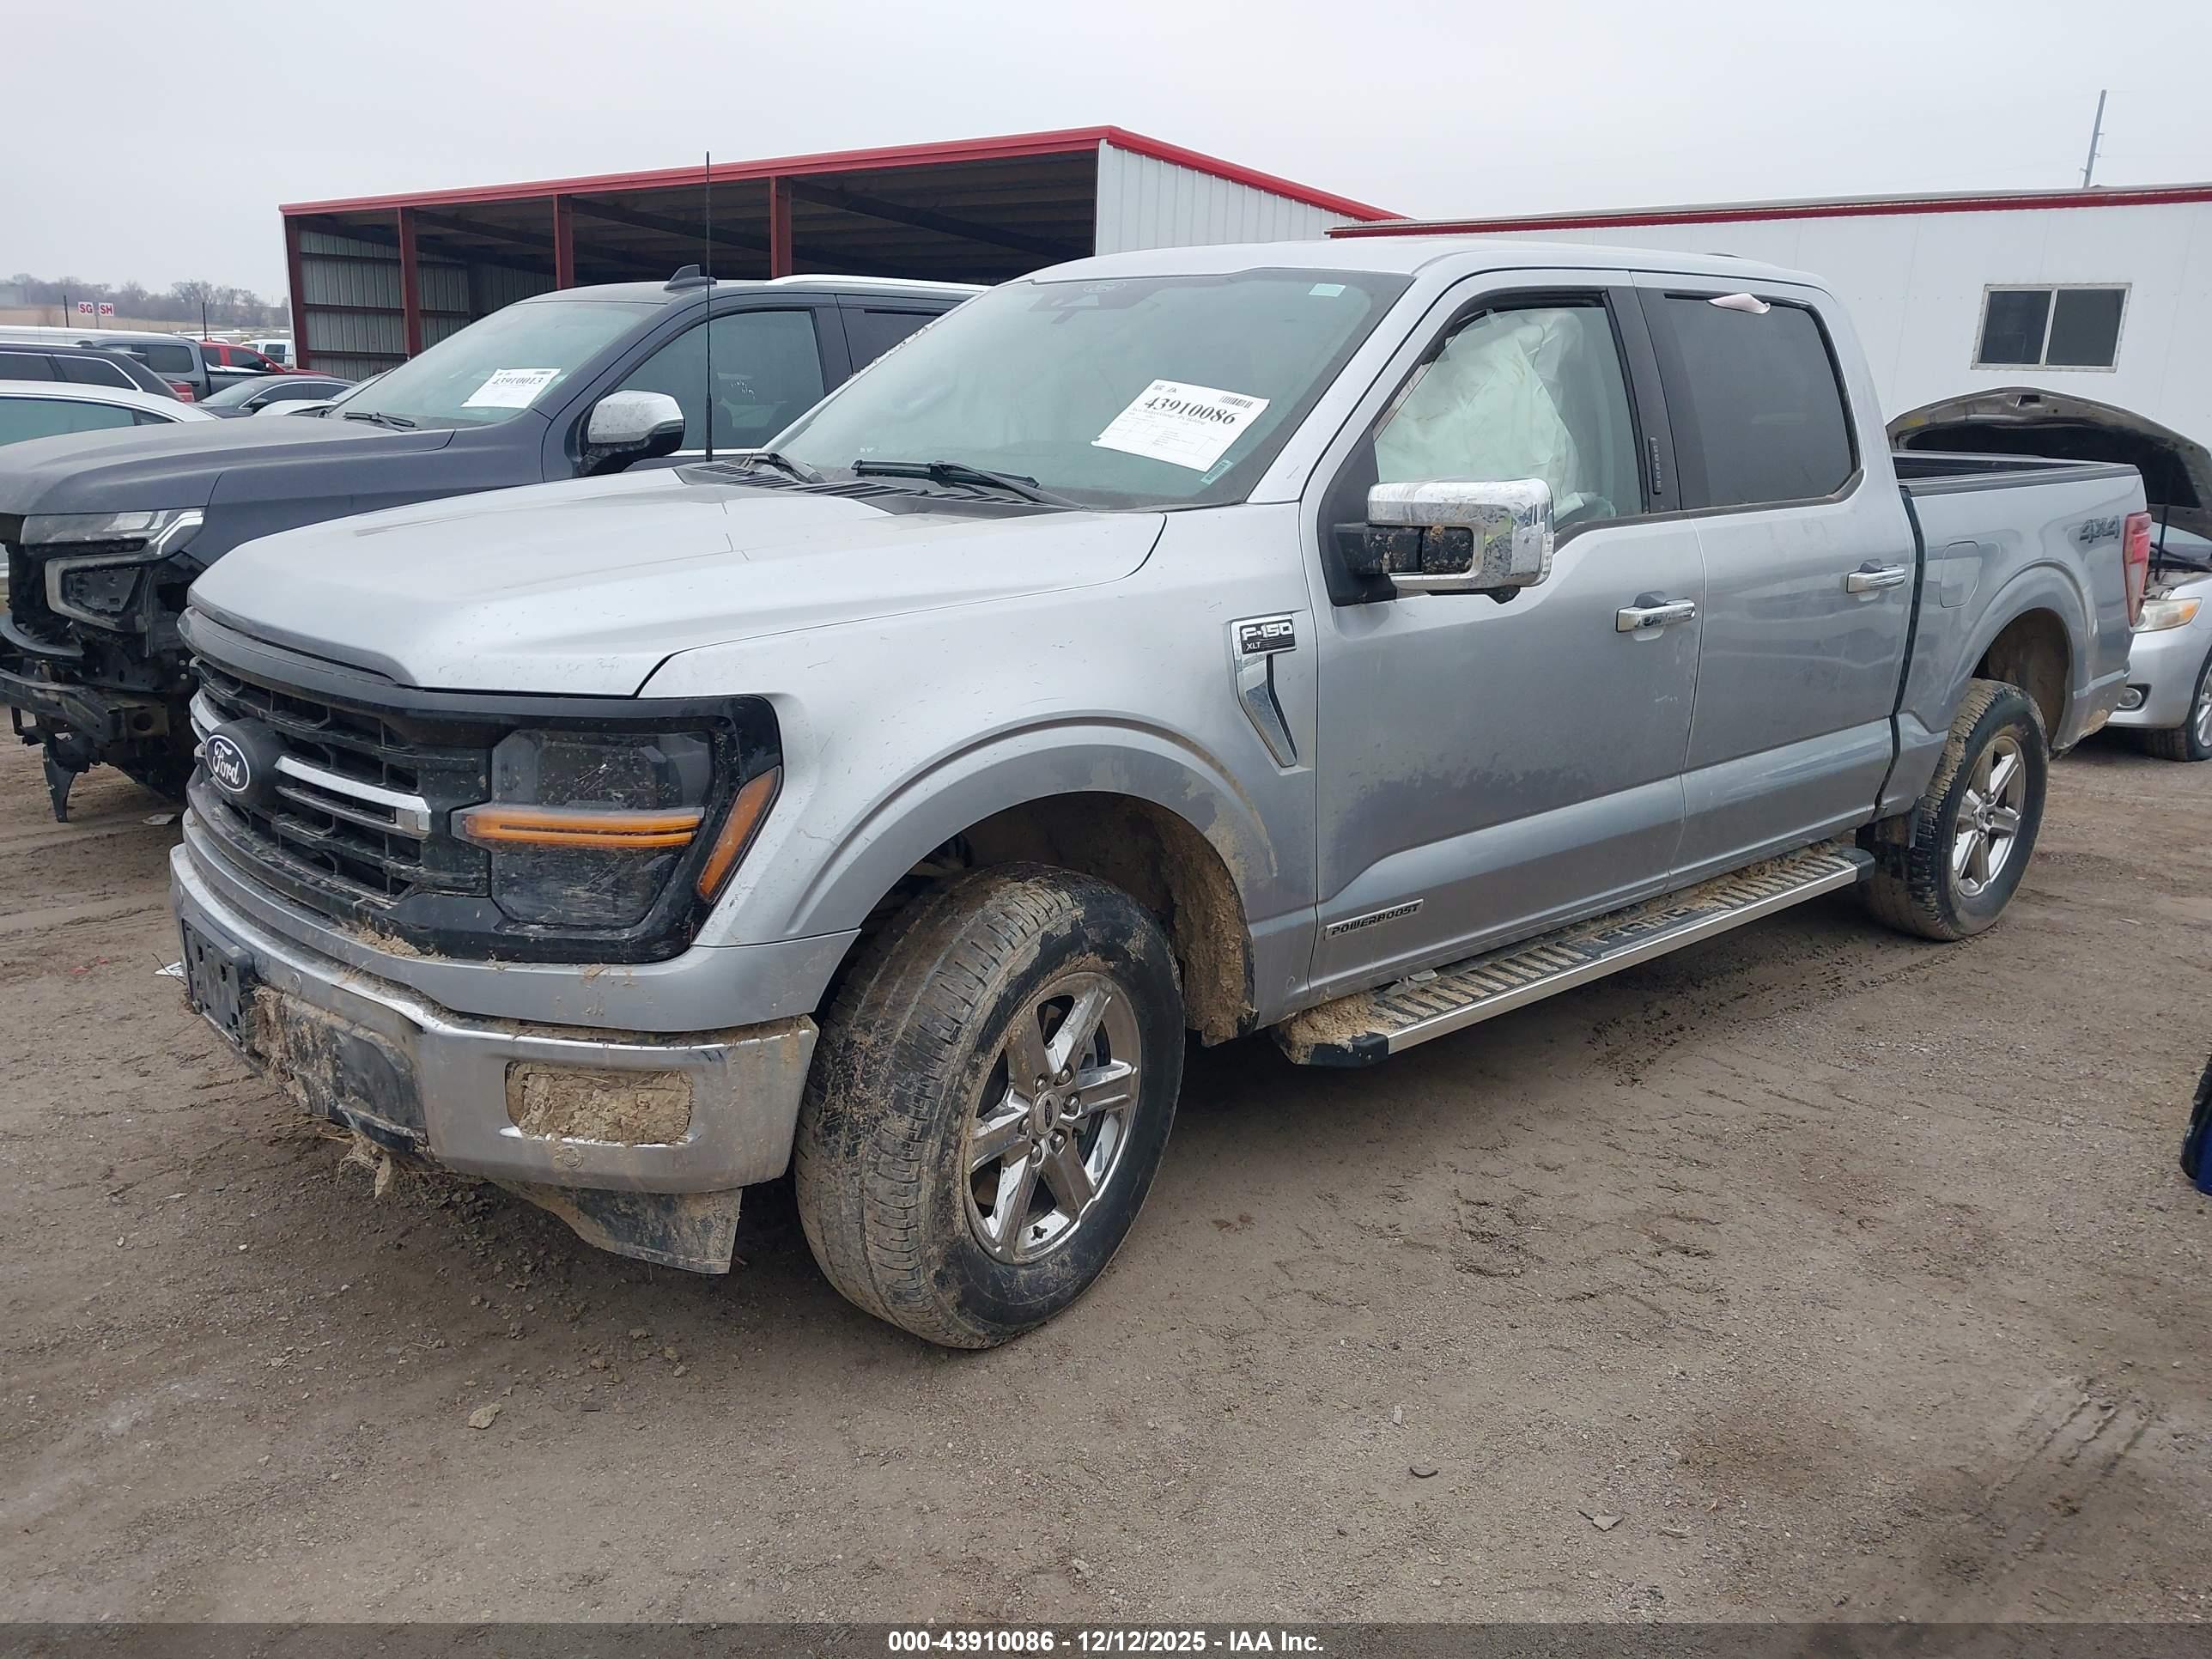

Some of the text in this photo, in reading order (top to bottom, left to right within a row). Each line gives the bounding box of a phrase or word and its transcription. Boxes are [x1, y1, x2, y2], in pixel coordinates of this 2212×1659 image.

[79, 303, 93, 314] SG
[100, 304, 113, 315] SH
[1144, 396, 1242, 425] 43910086
[1241, 622, 1294, 641] F-150
[1246, 641, 1261, 652] XLT
[212, 740, 240, 786] Ford
[1330, 902, 1421, 936] POWERBOOST
